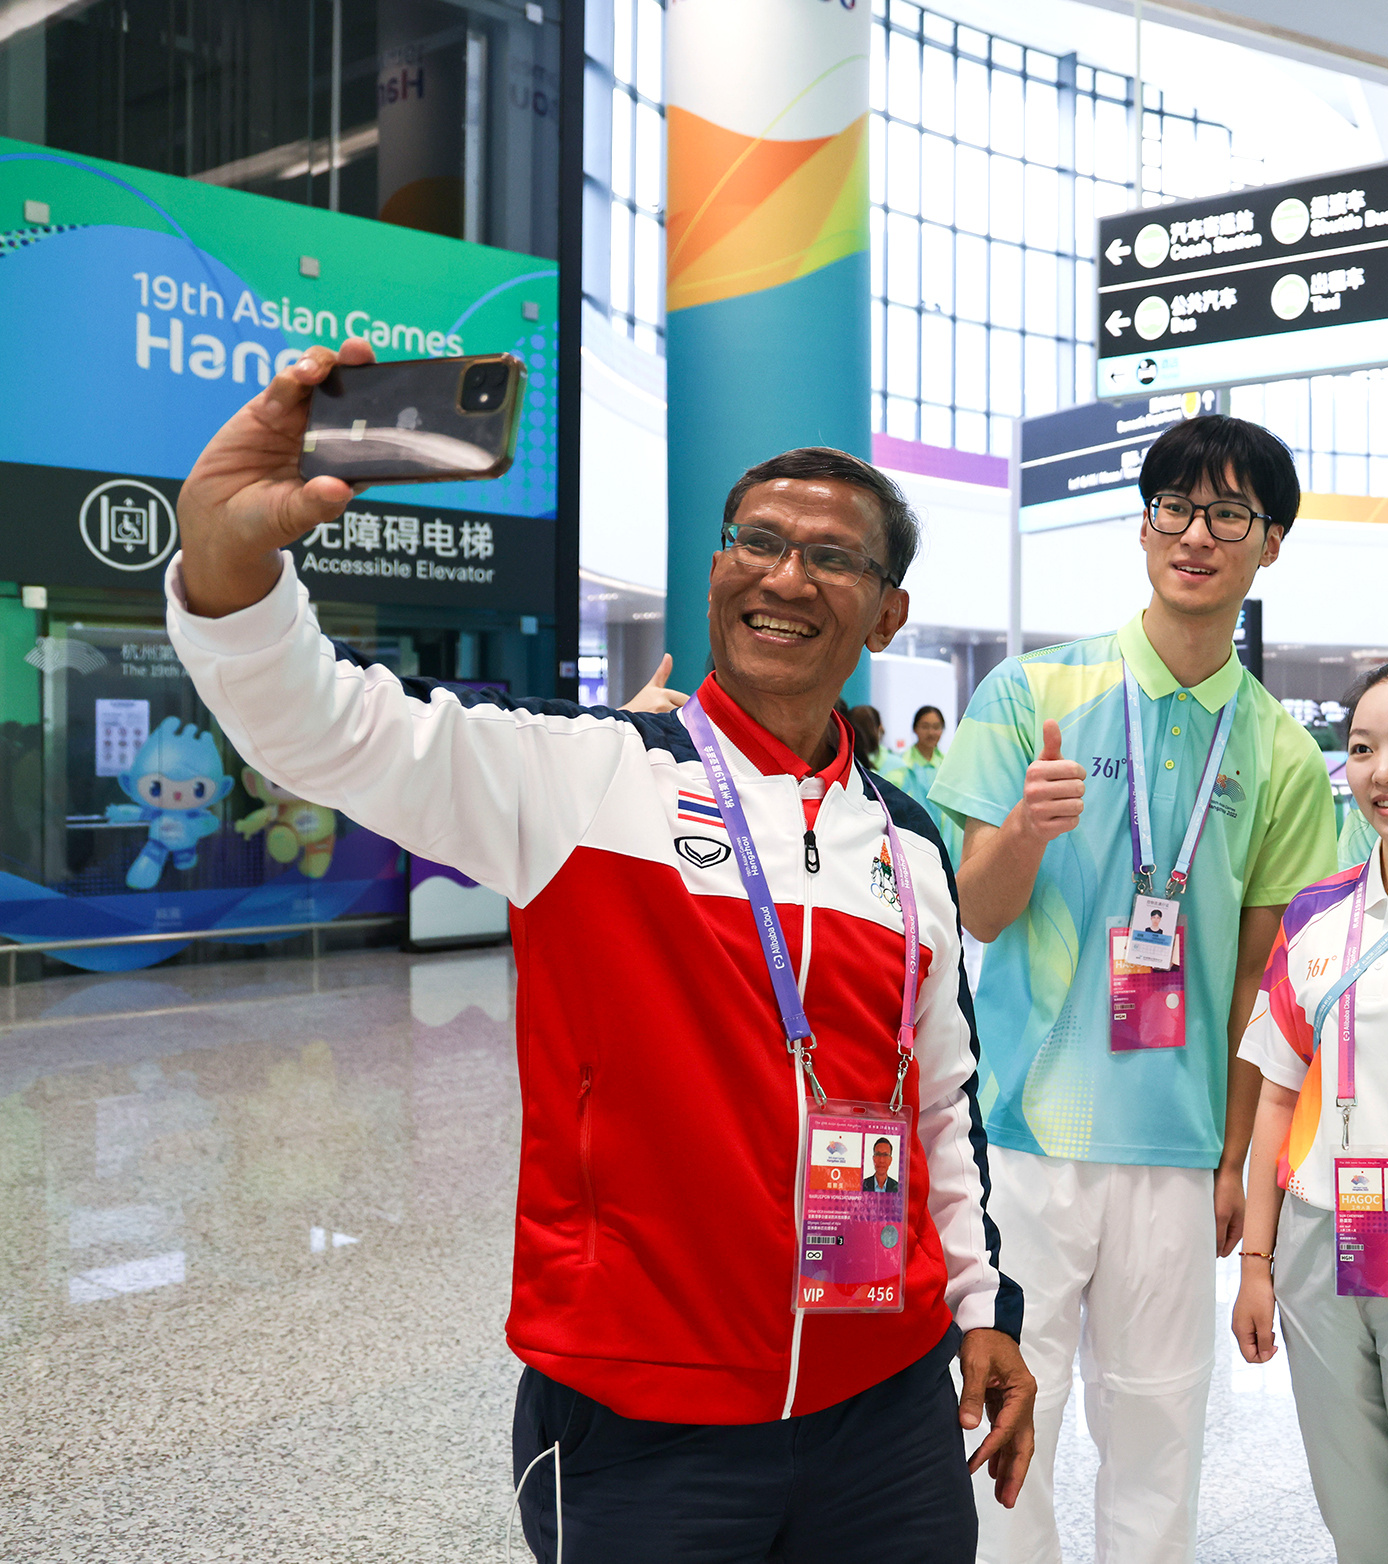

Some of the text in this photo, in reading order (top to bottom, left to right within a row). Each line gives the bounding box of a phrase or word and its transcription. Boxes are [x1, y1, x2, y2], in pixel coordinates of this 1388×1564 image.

[133, 272, 464, 357] 19th Asian Games
[1170, 316, 1197, 334] Bus
[302, 511, 495, 560] 无障碍电梯
[302, 552, 496, 585] Accessible Elevator
[122, 663, 147, 676] The
[703, 745, 735, 809] 杭州第19届亚运会
[1091, 757, 1127, 780] 361°
[741, 836, 759, 876] Hangzhou
[760, 906, 781, 954] Alibaba Cloud
[1305, 955, 1338, 981] 361°
[1343, 1011, 1351, 1031] Alibaba
[1341, 1194, 1381, 1205] HAGOC
[803, 1287, 894, 1302] VIP 456
